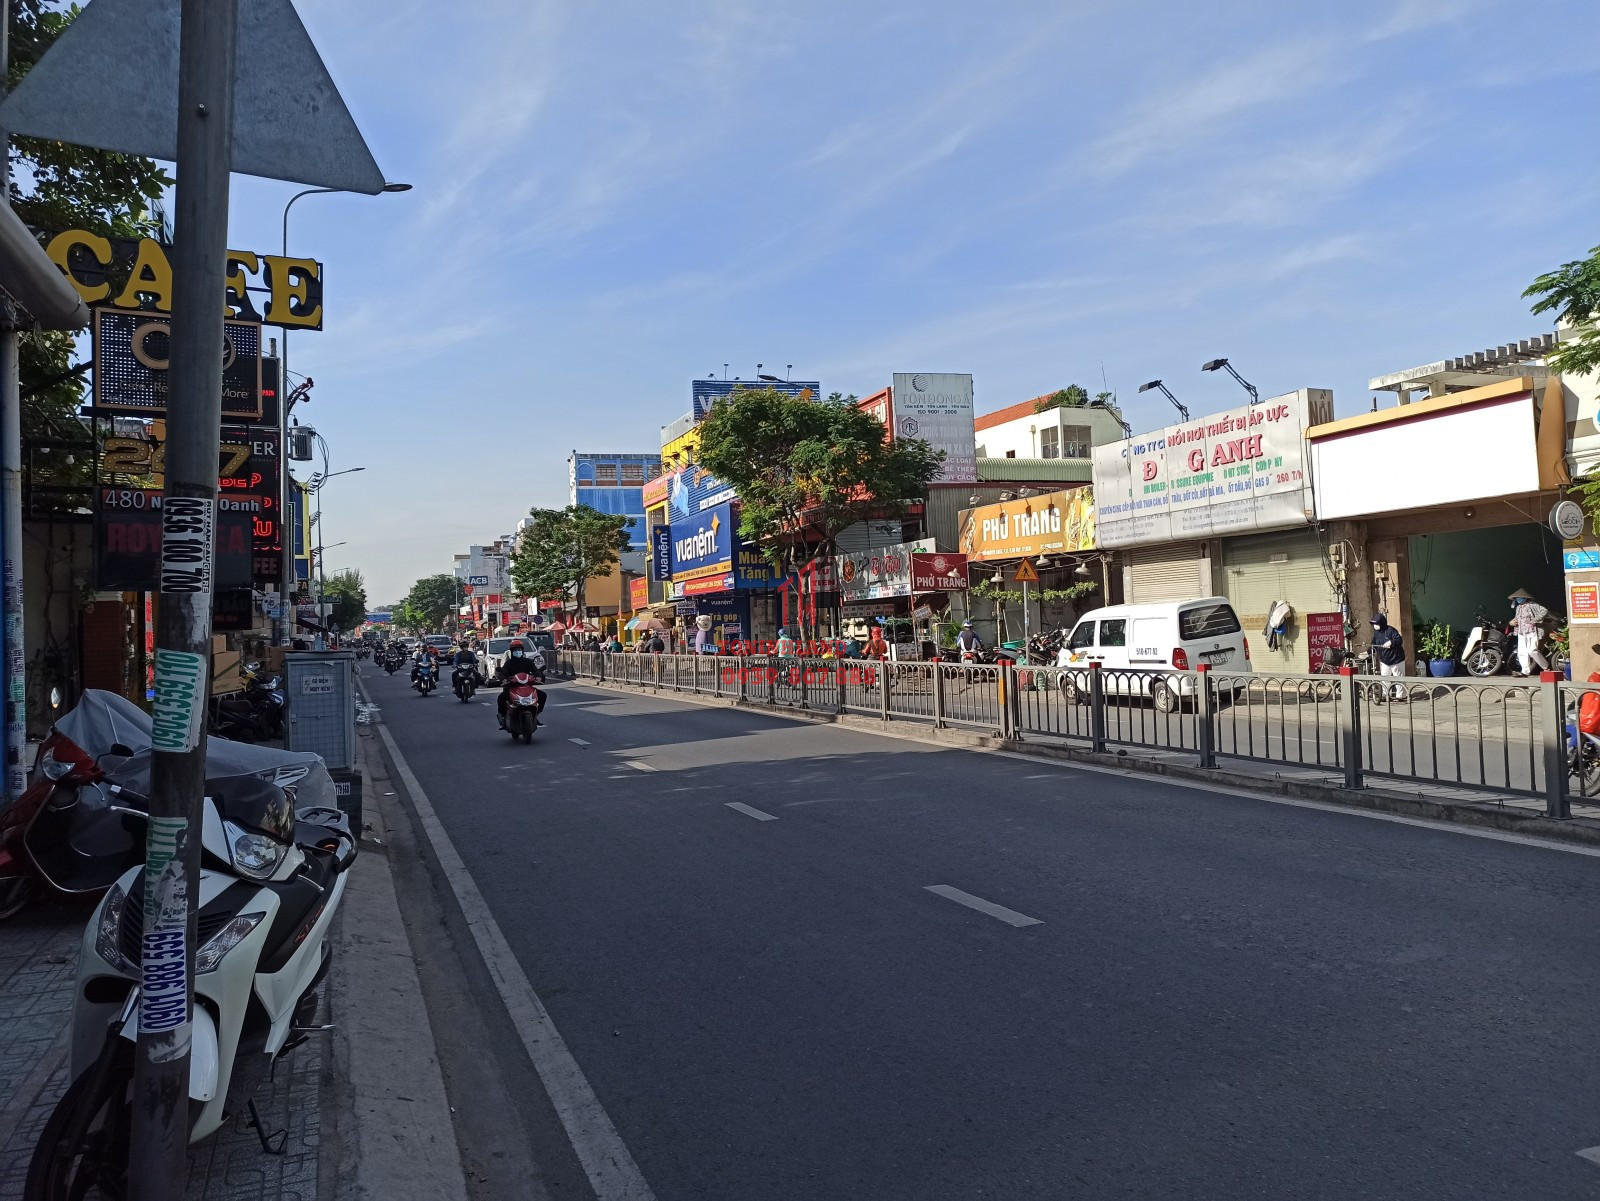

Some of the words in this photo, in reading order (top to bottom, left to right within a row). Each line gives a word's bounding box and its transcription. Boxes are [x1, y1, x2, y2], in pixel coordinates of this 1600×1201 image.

[1168, 428, 1186, 447] NỒI
[1206, 415, 1234, 439] THIẾT
[1266, 404, 1289, 423] LỰC
[1211, 434, 1264, 467] ANH
[1277, 471, 1289, 484] 260
[105, 489, 146, 509] 480
[220, 498, 260, 512] Oanh
[982, 511, 1009, 541] PHỞ
[1013, 507, 1061, 538] TRANG
[162, 499, 204, 593] 0936.100.700
[659, 532, 668, 580] vuanệm
[675, 527, 716, 562] vuanệm
[738, 552, 766, 567] Mua
[471, 577, 488, 586] ACB
[738, 565, 771, 583] Tặng
[916, 571, 935, 588] PHỞ
[937, 574, 967, 588] TRANG
[152, 652, 199, 748] 0903.559.110
[143, 931, 186, 1030] 0901.988.559
